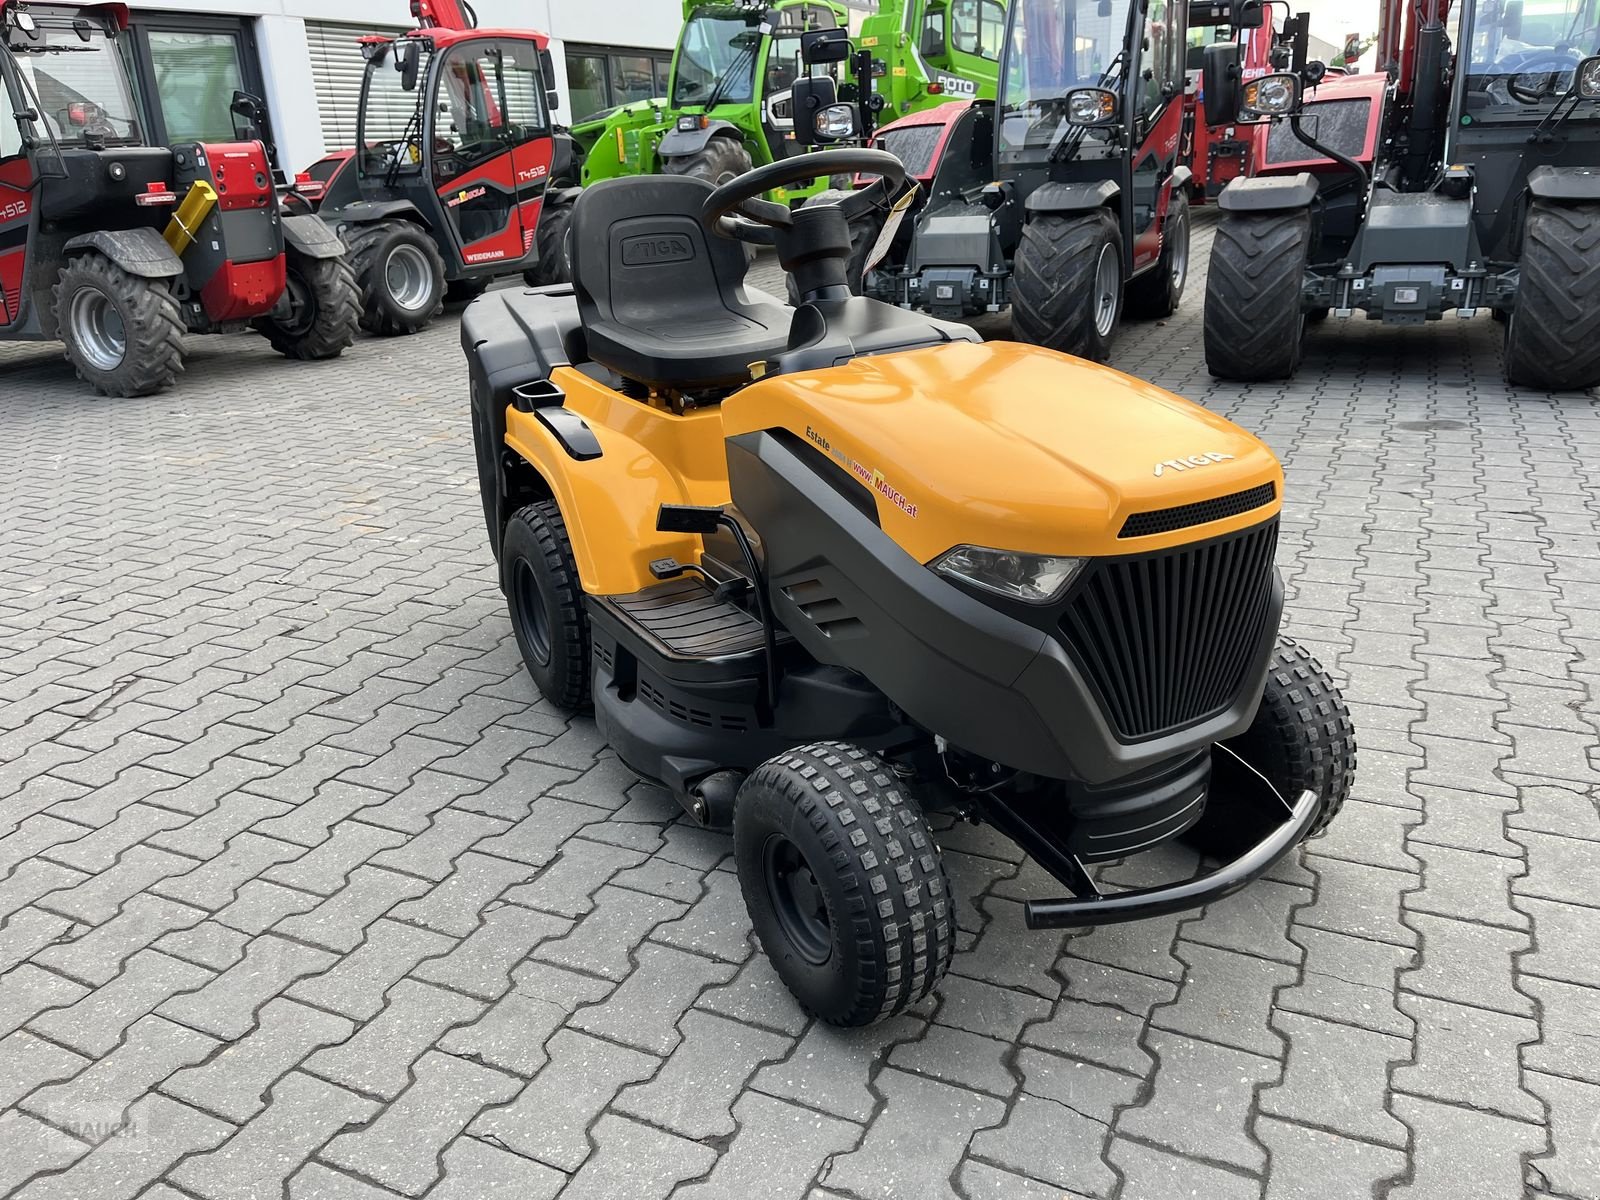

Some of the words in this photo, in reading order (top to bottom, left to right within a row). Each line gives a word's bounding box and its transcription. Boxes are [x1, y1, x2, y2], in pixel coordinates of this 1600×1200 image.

[937, 75, 974, 93] ROTO
[518, 165, 546, 181] T4512
[627, 240, 688, 258] STIGA
[805, 425, 830, 452] Estate
[1153, 451, 1235, 477] STIGA
